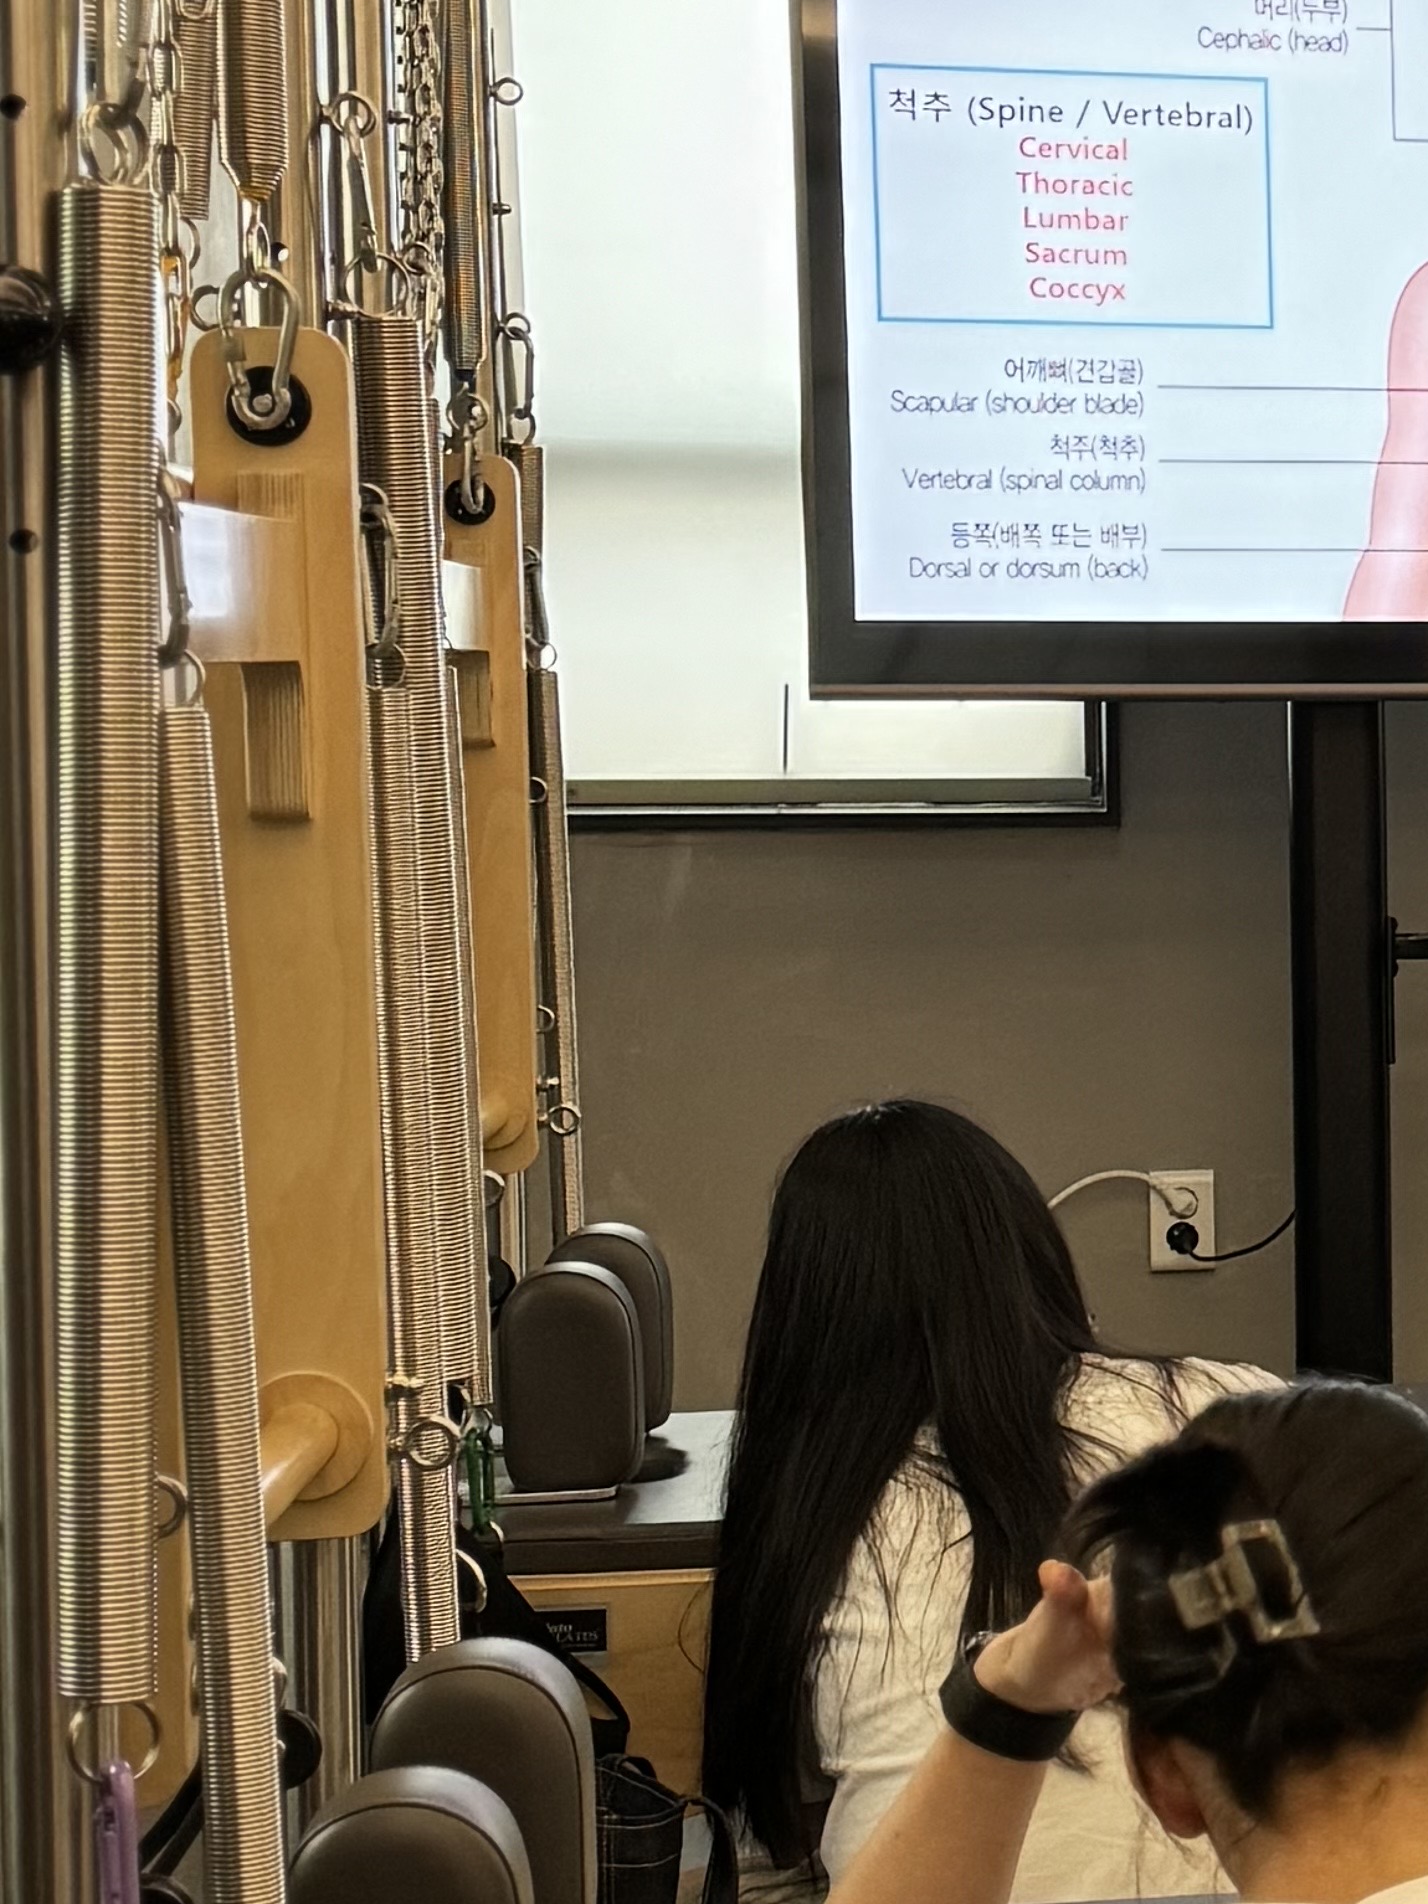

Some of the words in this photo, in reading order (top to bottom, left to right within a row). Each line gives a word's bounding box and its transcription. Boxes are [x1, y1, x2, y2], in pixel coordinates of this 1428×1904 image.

[1198, 26, 1281, 51] Cephalic
[1288, 28, 1348, 55] (head)
[889, 88, 952, 123] 척추
[968, 96, 1063, 128] (Spine
[1076, 99, 1090, 129] /
[1102, 100, 1252, 135] Vertebral)
[1019, 136, 1127, 160] Cervical
[1015, 171, 1133, 196] Thoracic
[1024, 206, 1128, 231] Lumbar
[1026, 242, 1127, 265] Sacrum
[1030, 277, 1125, 307] Coccyx
[891, 390, 978, 415] Scapular
[986, 389, 1077, 416] (shoulder
[1085, 391, 1144, 417] blade)
[902, 468, 992, 490] Vertebral
[1000, 467, 1062, 495] (spinal
[1070, 467, 1145, 494] column)
[1052, 523, 1092, 548] 또는
[1100, 523, 1146, 549] 배부)
[909, 557, 971, 578] Dorsal
[979, 562, 999, 578] or
[1007, 558, 1080, 579] dorsum
[1088, 554, 1148, 581] (back)
